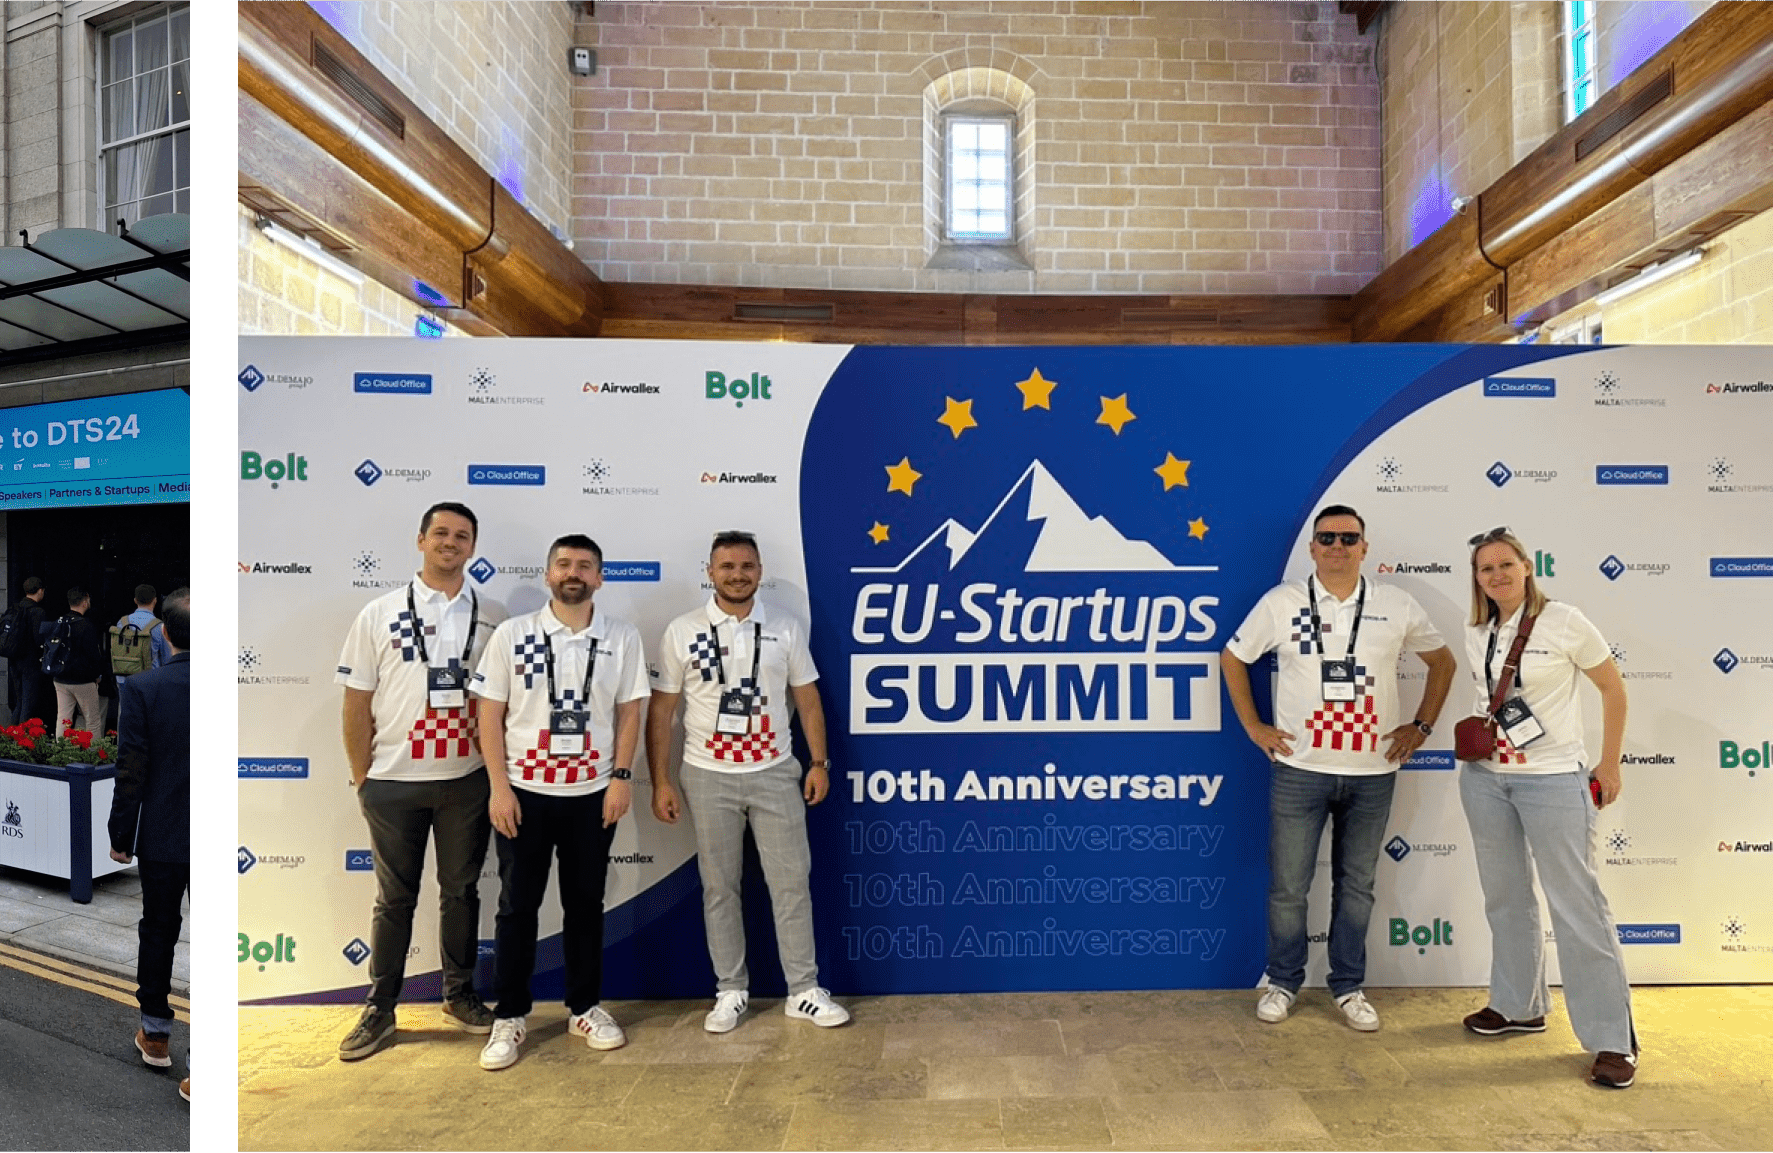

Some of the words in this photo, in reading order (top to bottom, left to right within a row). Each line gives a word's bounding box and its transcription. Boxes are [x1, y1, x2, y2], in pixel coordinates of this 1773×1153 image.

[373, 379, 399, 388] Cloud
[400, 379, 426, 389] Office
[600, 382, 660, 394] Airwallex
[705, 371, 772, 408] Bolt
[1500, 383, 1525, 392] Cloud
[1525, 383, 1551, 392] Office
[12, 427, 38, 449] to
[47, 414, 140, 446] DTS24
[240, 450, 308, 490] Bolt
[486, 471, 512, 480] Cloud
[513, 471, 539, 481] Office
[1613, 470, 1639, 480] Cloud
[1639, 470, 1663, 480] Office
[718, 472, 777, 484] Airwallex
[49, 487, 92, 499] Partners
[95, 486, 102, 496] &
[104, 485, 150, 498] Startups
[252, 562, 312, 574] Airwallex
[1394, 563, 1452, 574] Airwallex
[1535, 550, 1555, 577] lt
[1728, 563, 1751, 571] Cloud
[602, 567, 627, 576] Cloud
[628, 567, 655, 576] Office
[852, 583, 1219, 652] EU-Startups
[865, 663, 1209, 723] SUMMIT
[1620, 753, 1675, 765] Airwallex
[1719, 740, 1773, 778] Bol
[249, 764, 276, 772] Cloud
[277, 764, 303, 773] Office
[847, 770, 945, 803] 10th
[954, 763, 1224, 807] Anniversary
[2, 825, 24, 839] RDS
[845, 820, 945, 854] 10th
[953, 813, 1225, 857] Anniversary
[1734, 840, 1773, 852] Airwal
[608, 852, 654, 864] rwallex
[843, 873, 945, 907] 10th
[952, 865, 1226, 909] Anniversary
[842, 925, 944, 960] 10th
[951, 917, 1226, 961] Anniversary
[1389, 918, 1453, 955] Bolt
[1625, 929, 1651, 938] Cloud
[1651, 929, 1676, 938] Office
